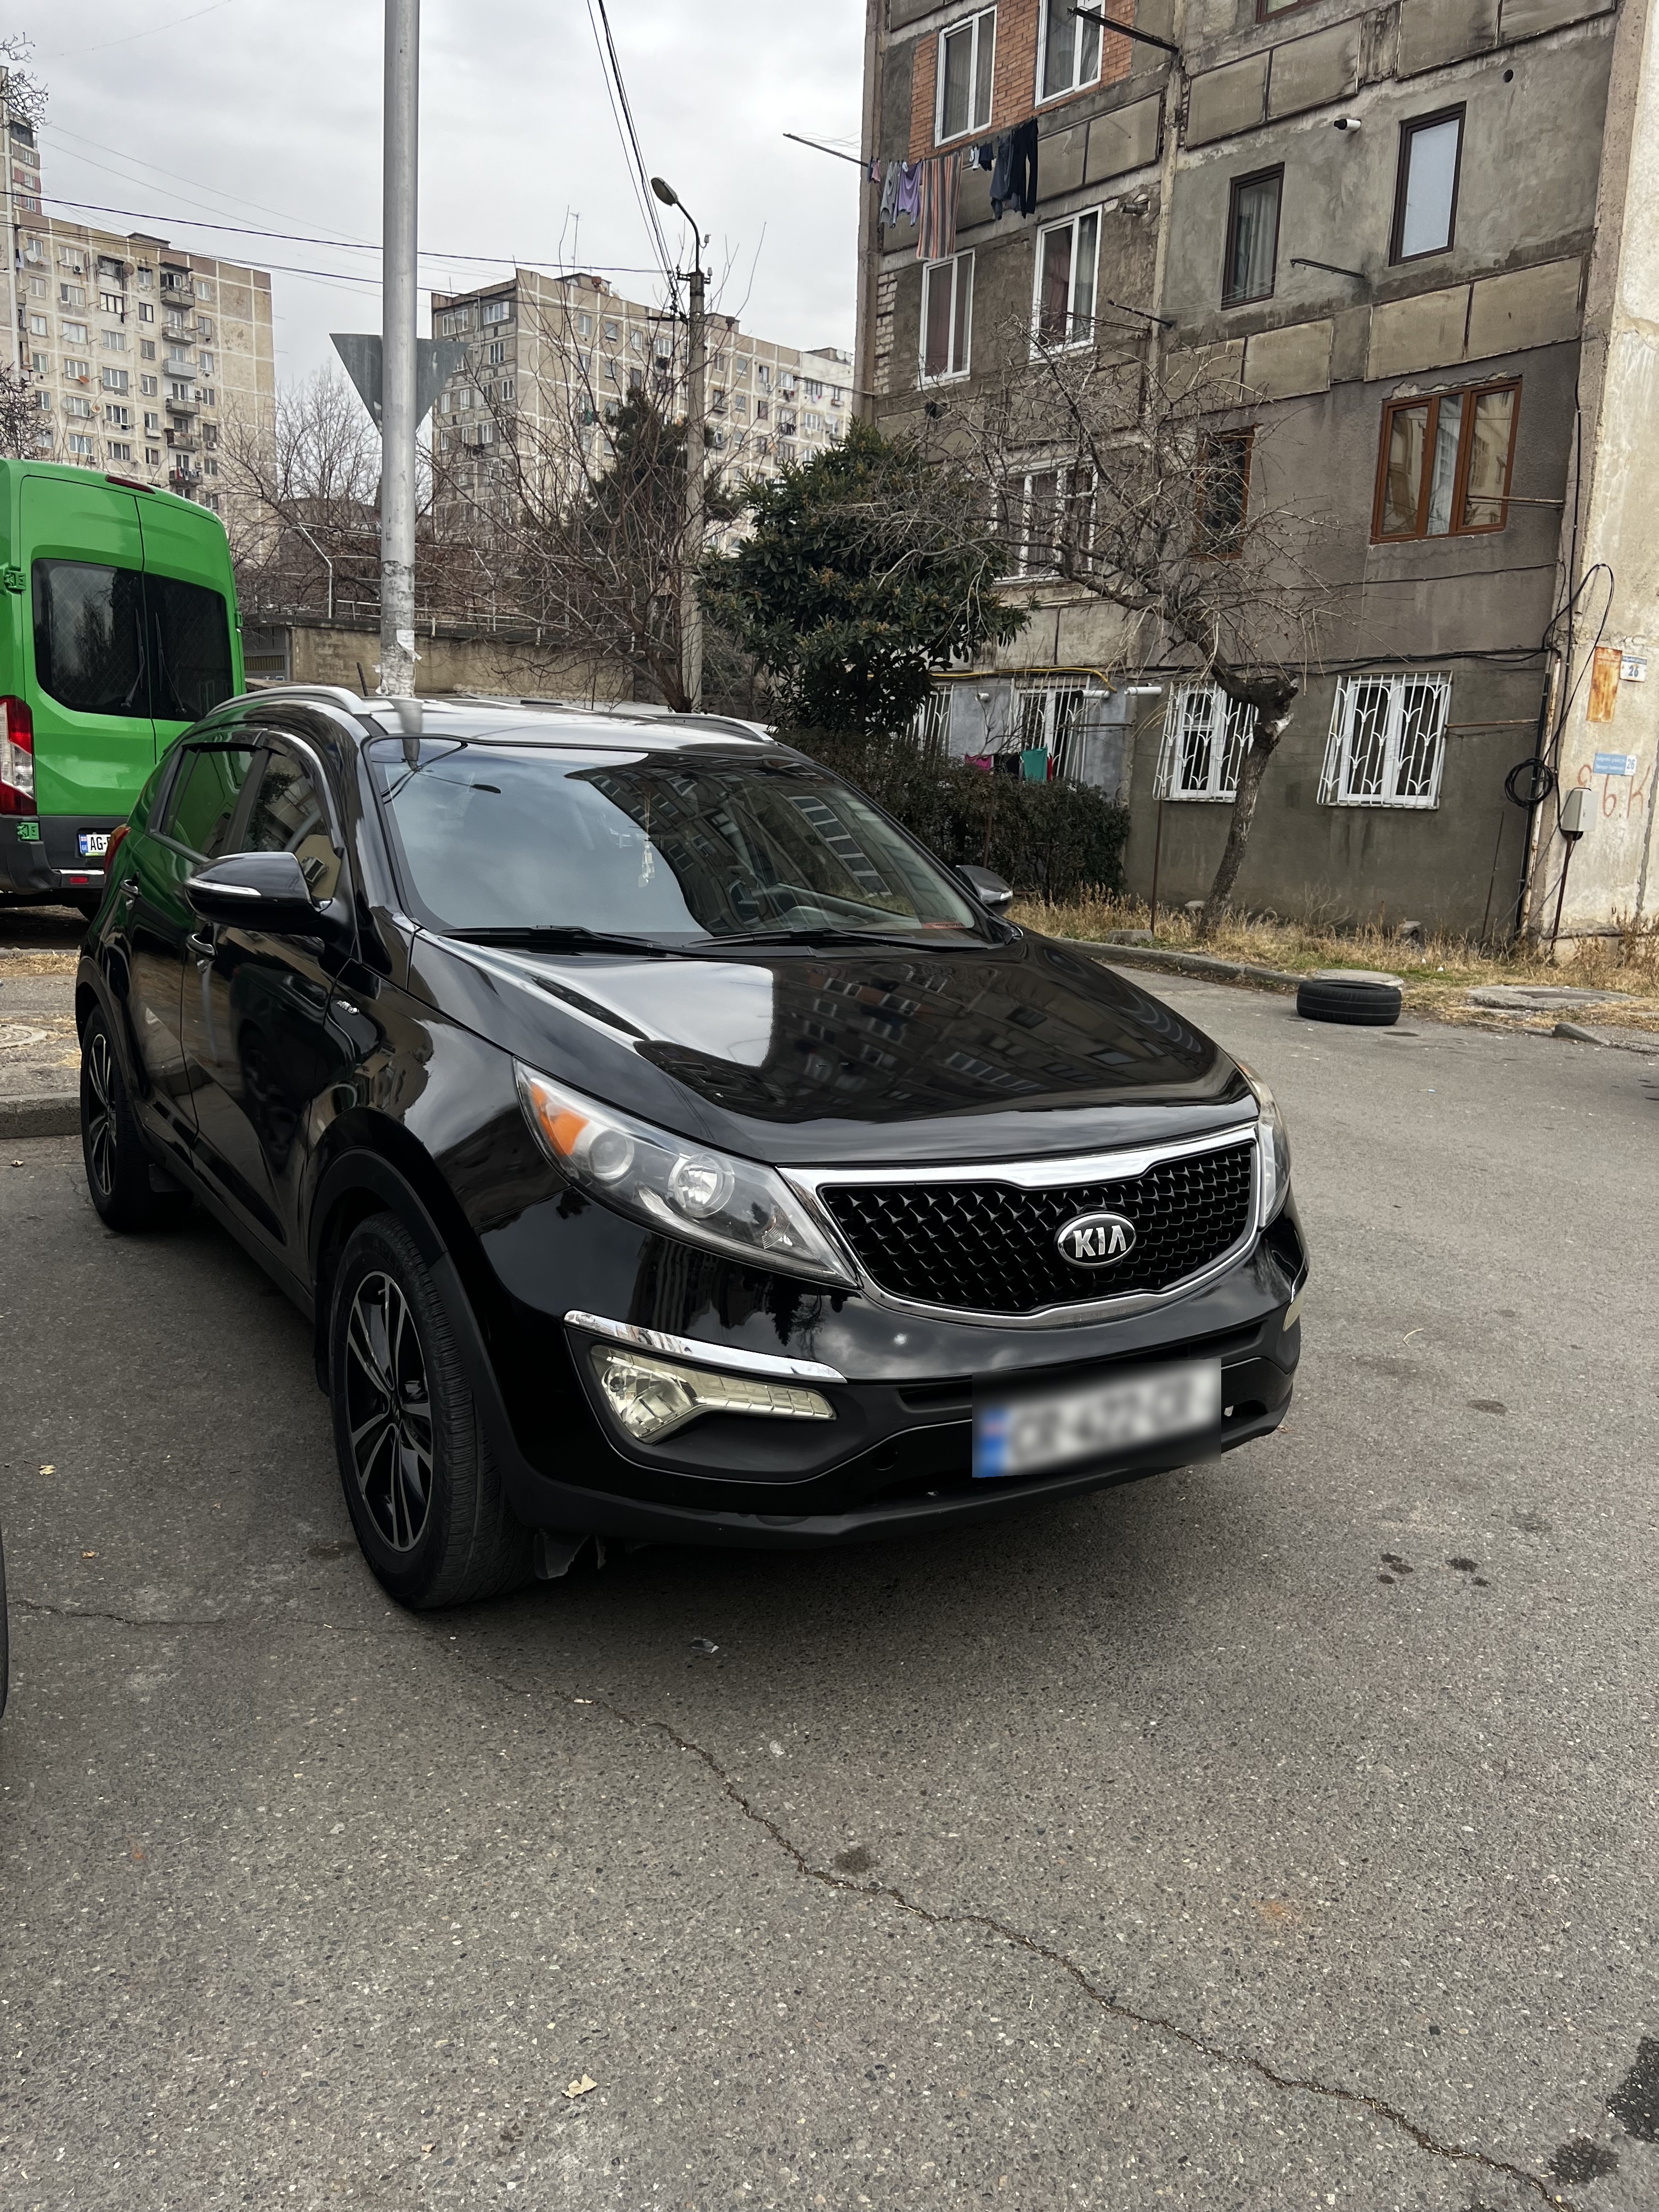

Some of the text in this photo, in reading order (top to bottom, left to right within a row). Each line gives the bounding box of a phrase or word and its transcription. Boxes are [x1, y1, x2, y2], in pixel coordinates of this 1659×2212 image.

[1628, 664, 1639, 677] 26
[1627, 759, 1635, 770] 26
[91, 837, 111, 850] AG-
[1073, 1224, 1126, 1258] KIA
